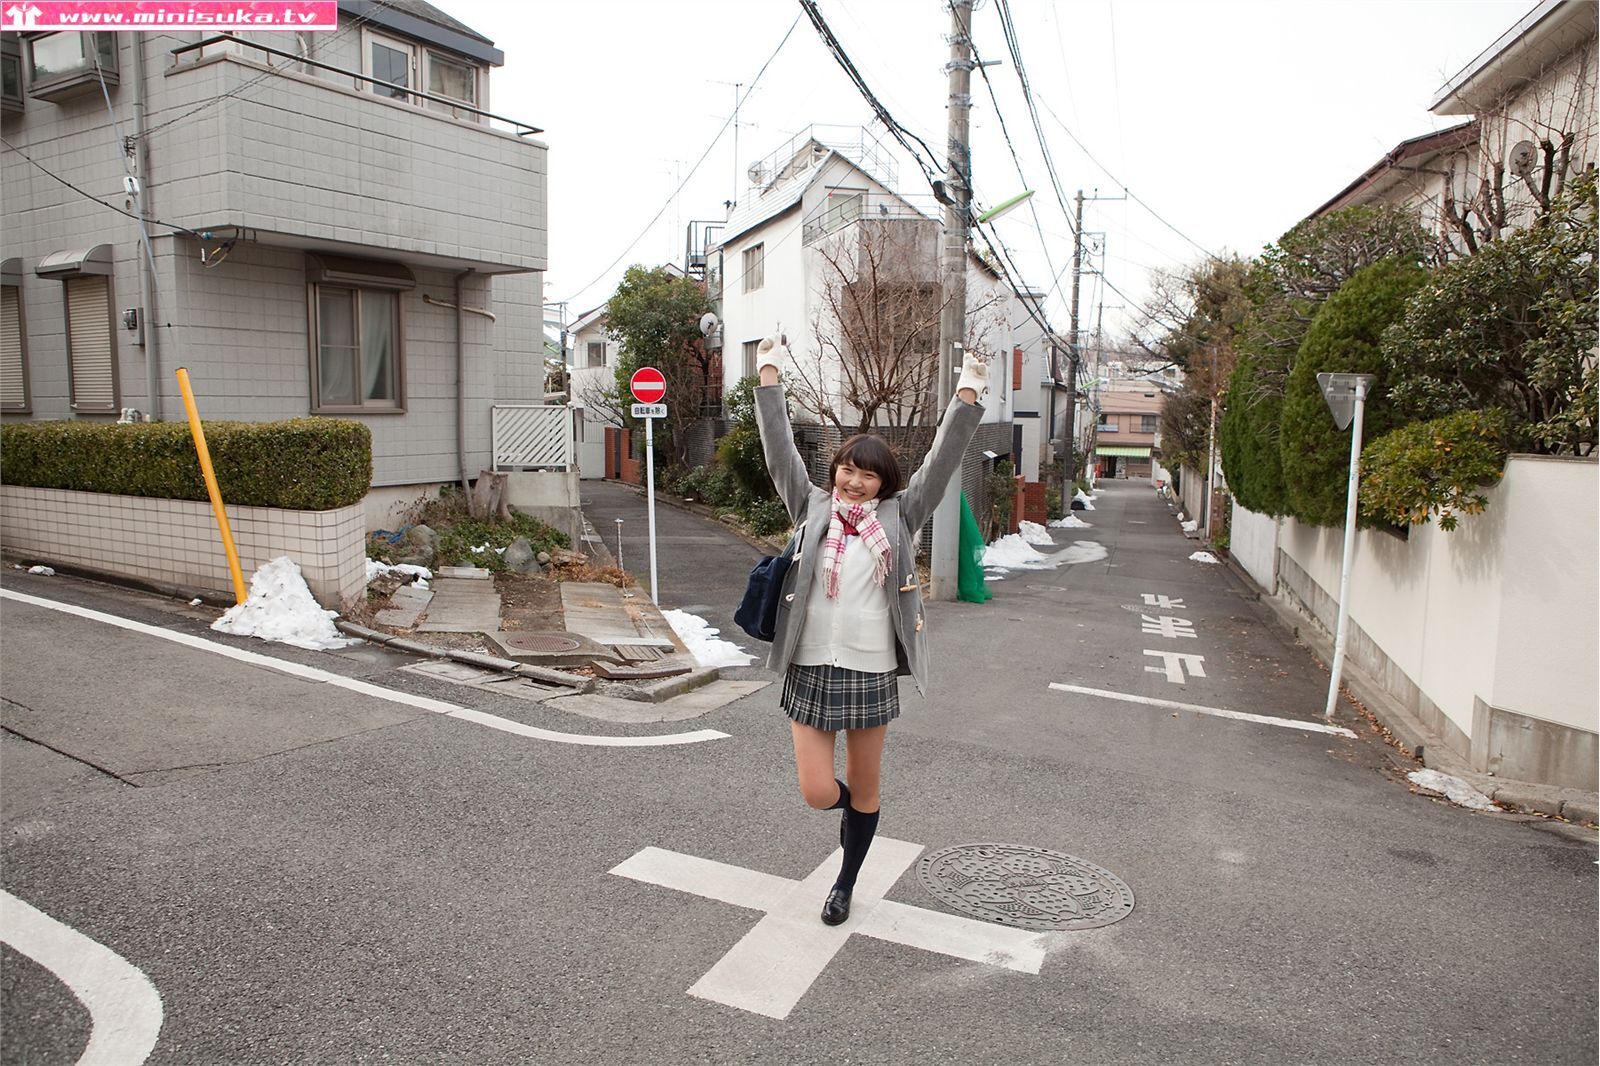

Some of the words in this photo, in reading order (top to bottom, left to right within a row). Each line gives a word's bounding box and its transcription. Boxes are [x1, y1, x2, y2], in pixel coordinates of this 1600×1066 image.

[634, 406, 665, 415] 自転車を除く
[1140, 593, 1206, 684] 止まれ
